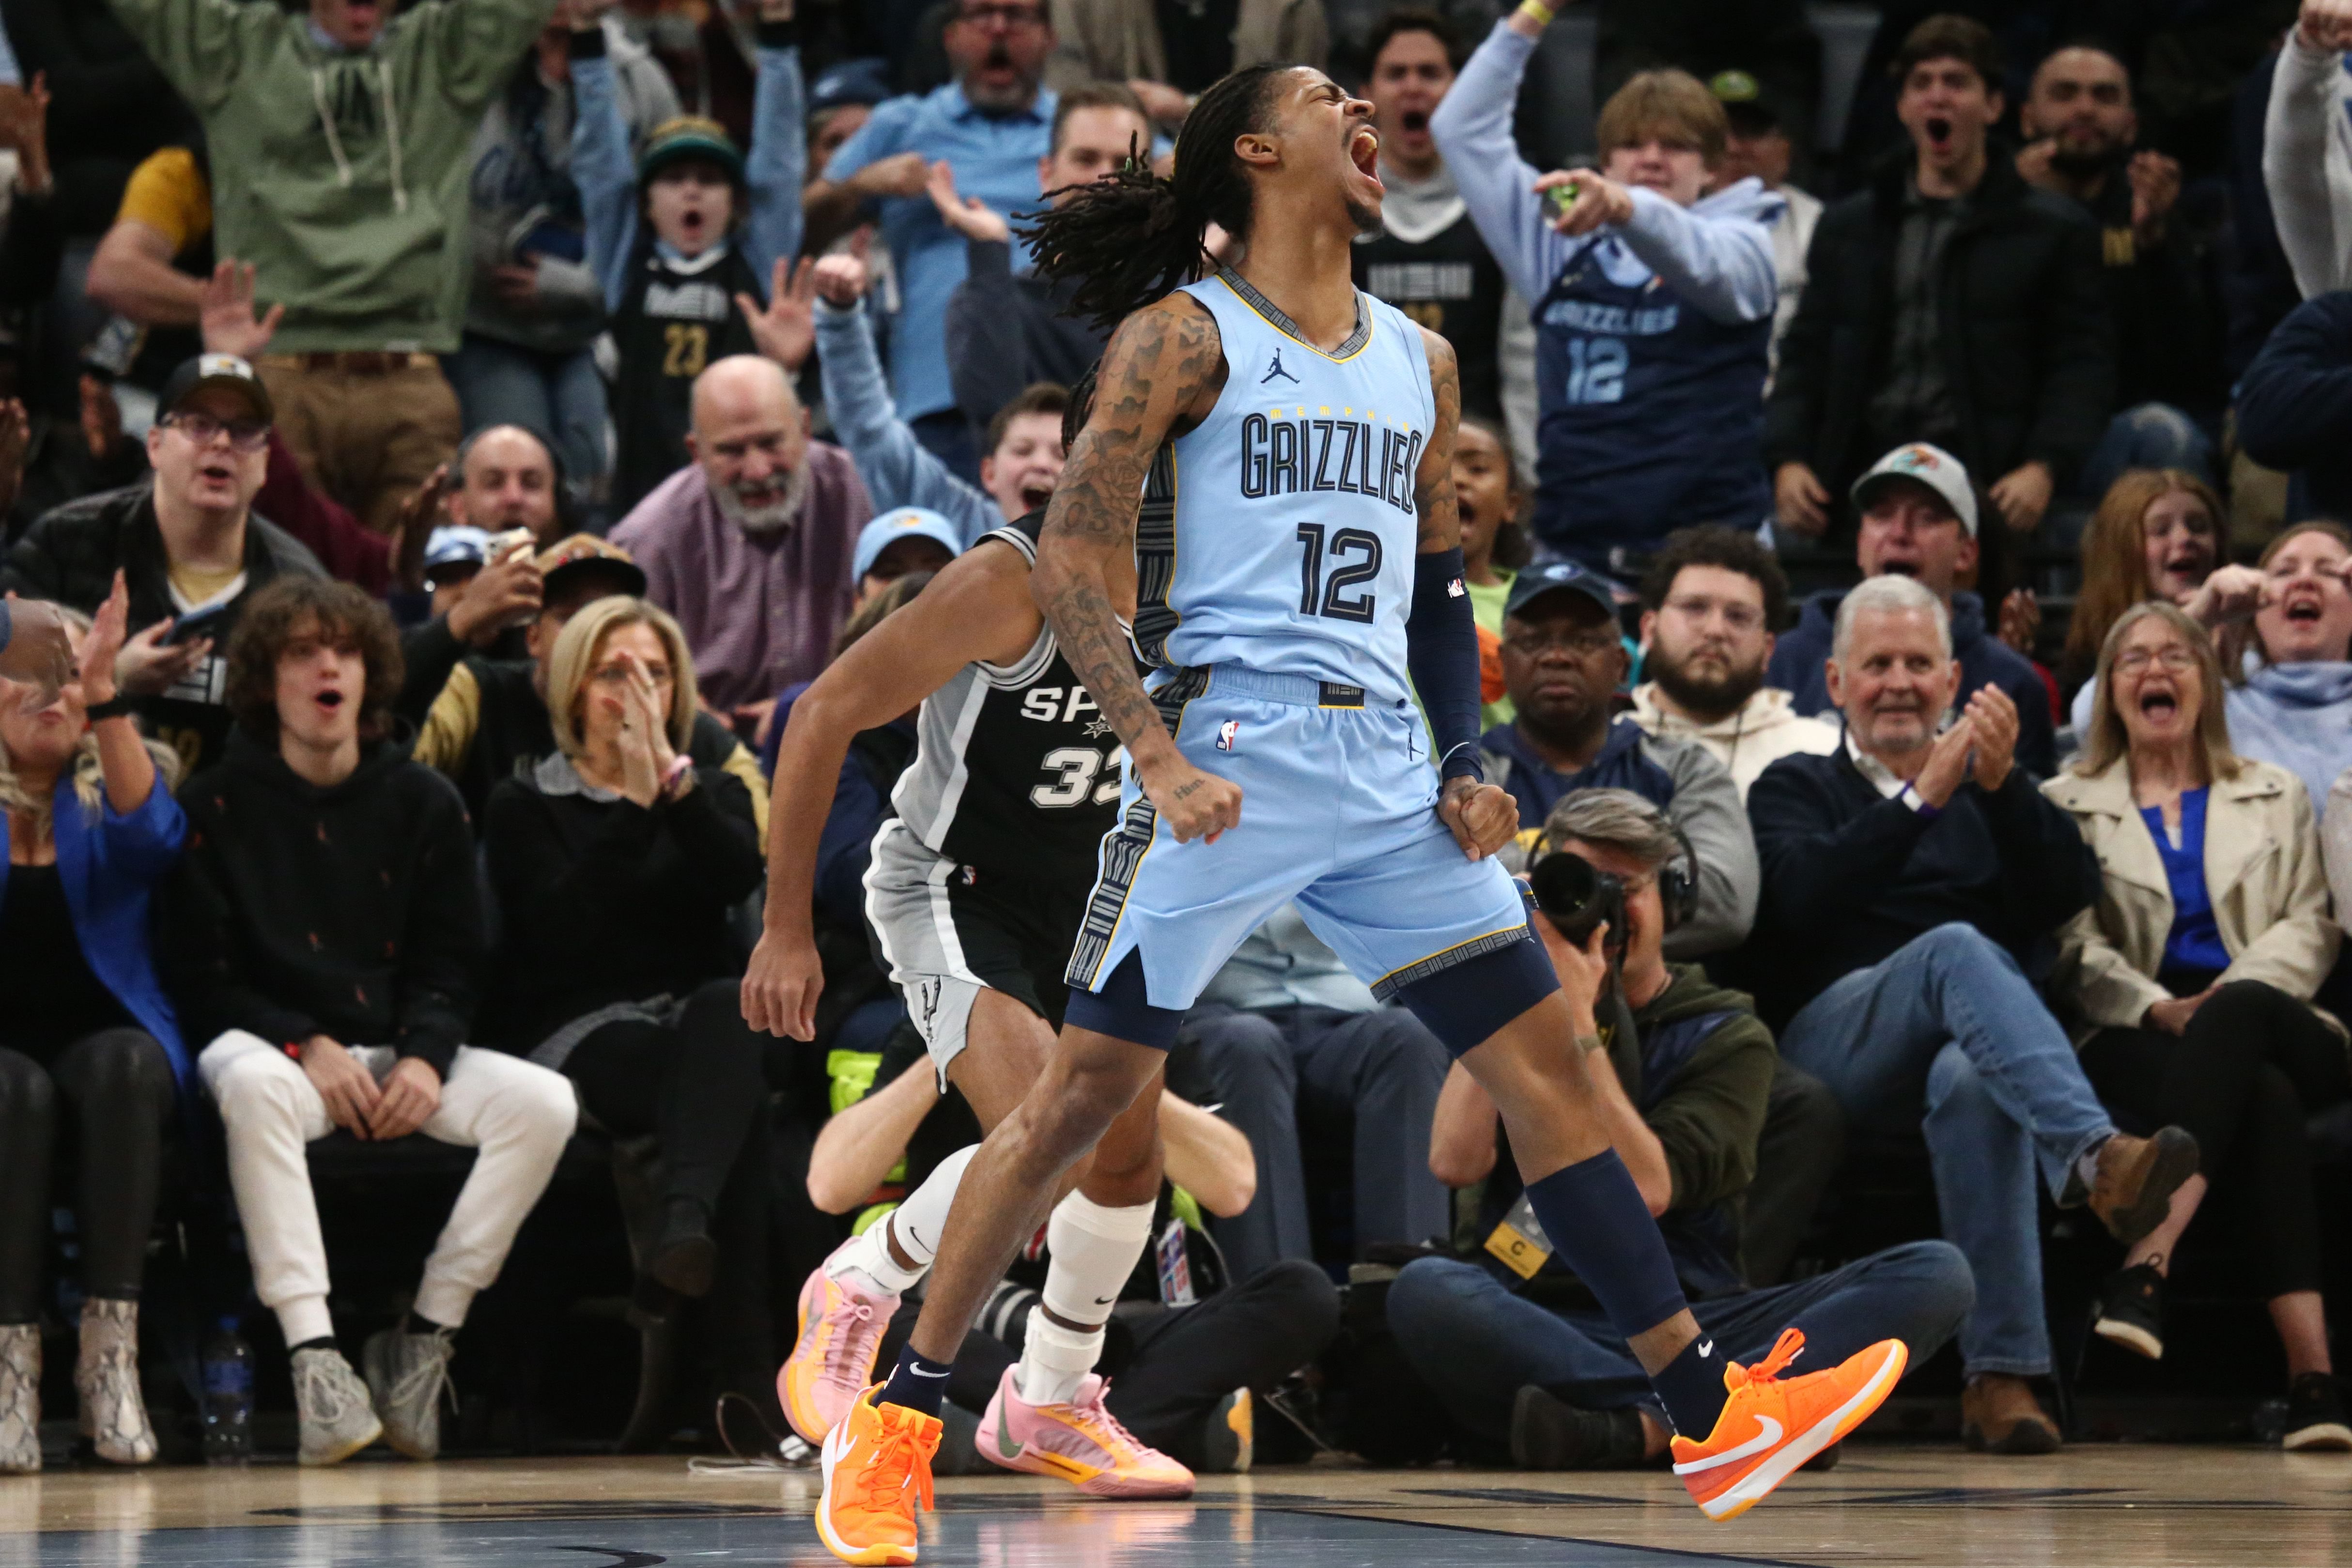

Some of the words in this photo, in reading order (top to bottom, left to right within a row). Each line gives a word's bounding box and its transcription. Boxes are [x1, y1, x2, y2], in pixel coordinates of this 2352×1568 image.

[1566, 338, 1629, 404] 12
[1270, 405, 1408, 432] MEMPHIS
[1241, 413, 1422, 515] GRIZZLIES
[1297, 522, 1382, 624] 12
[1511, 1241, 1525, 1256] C
